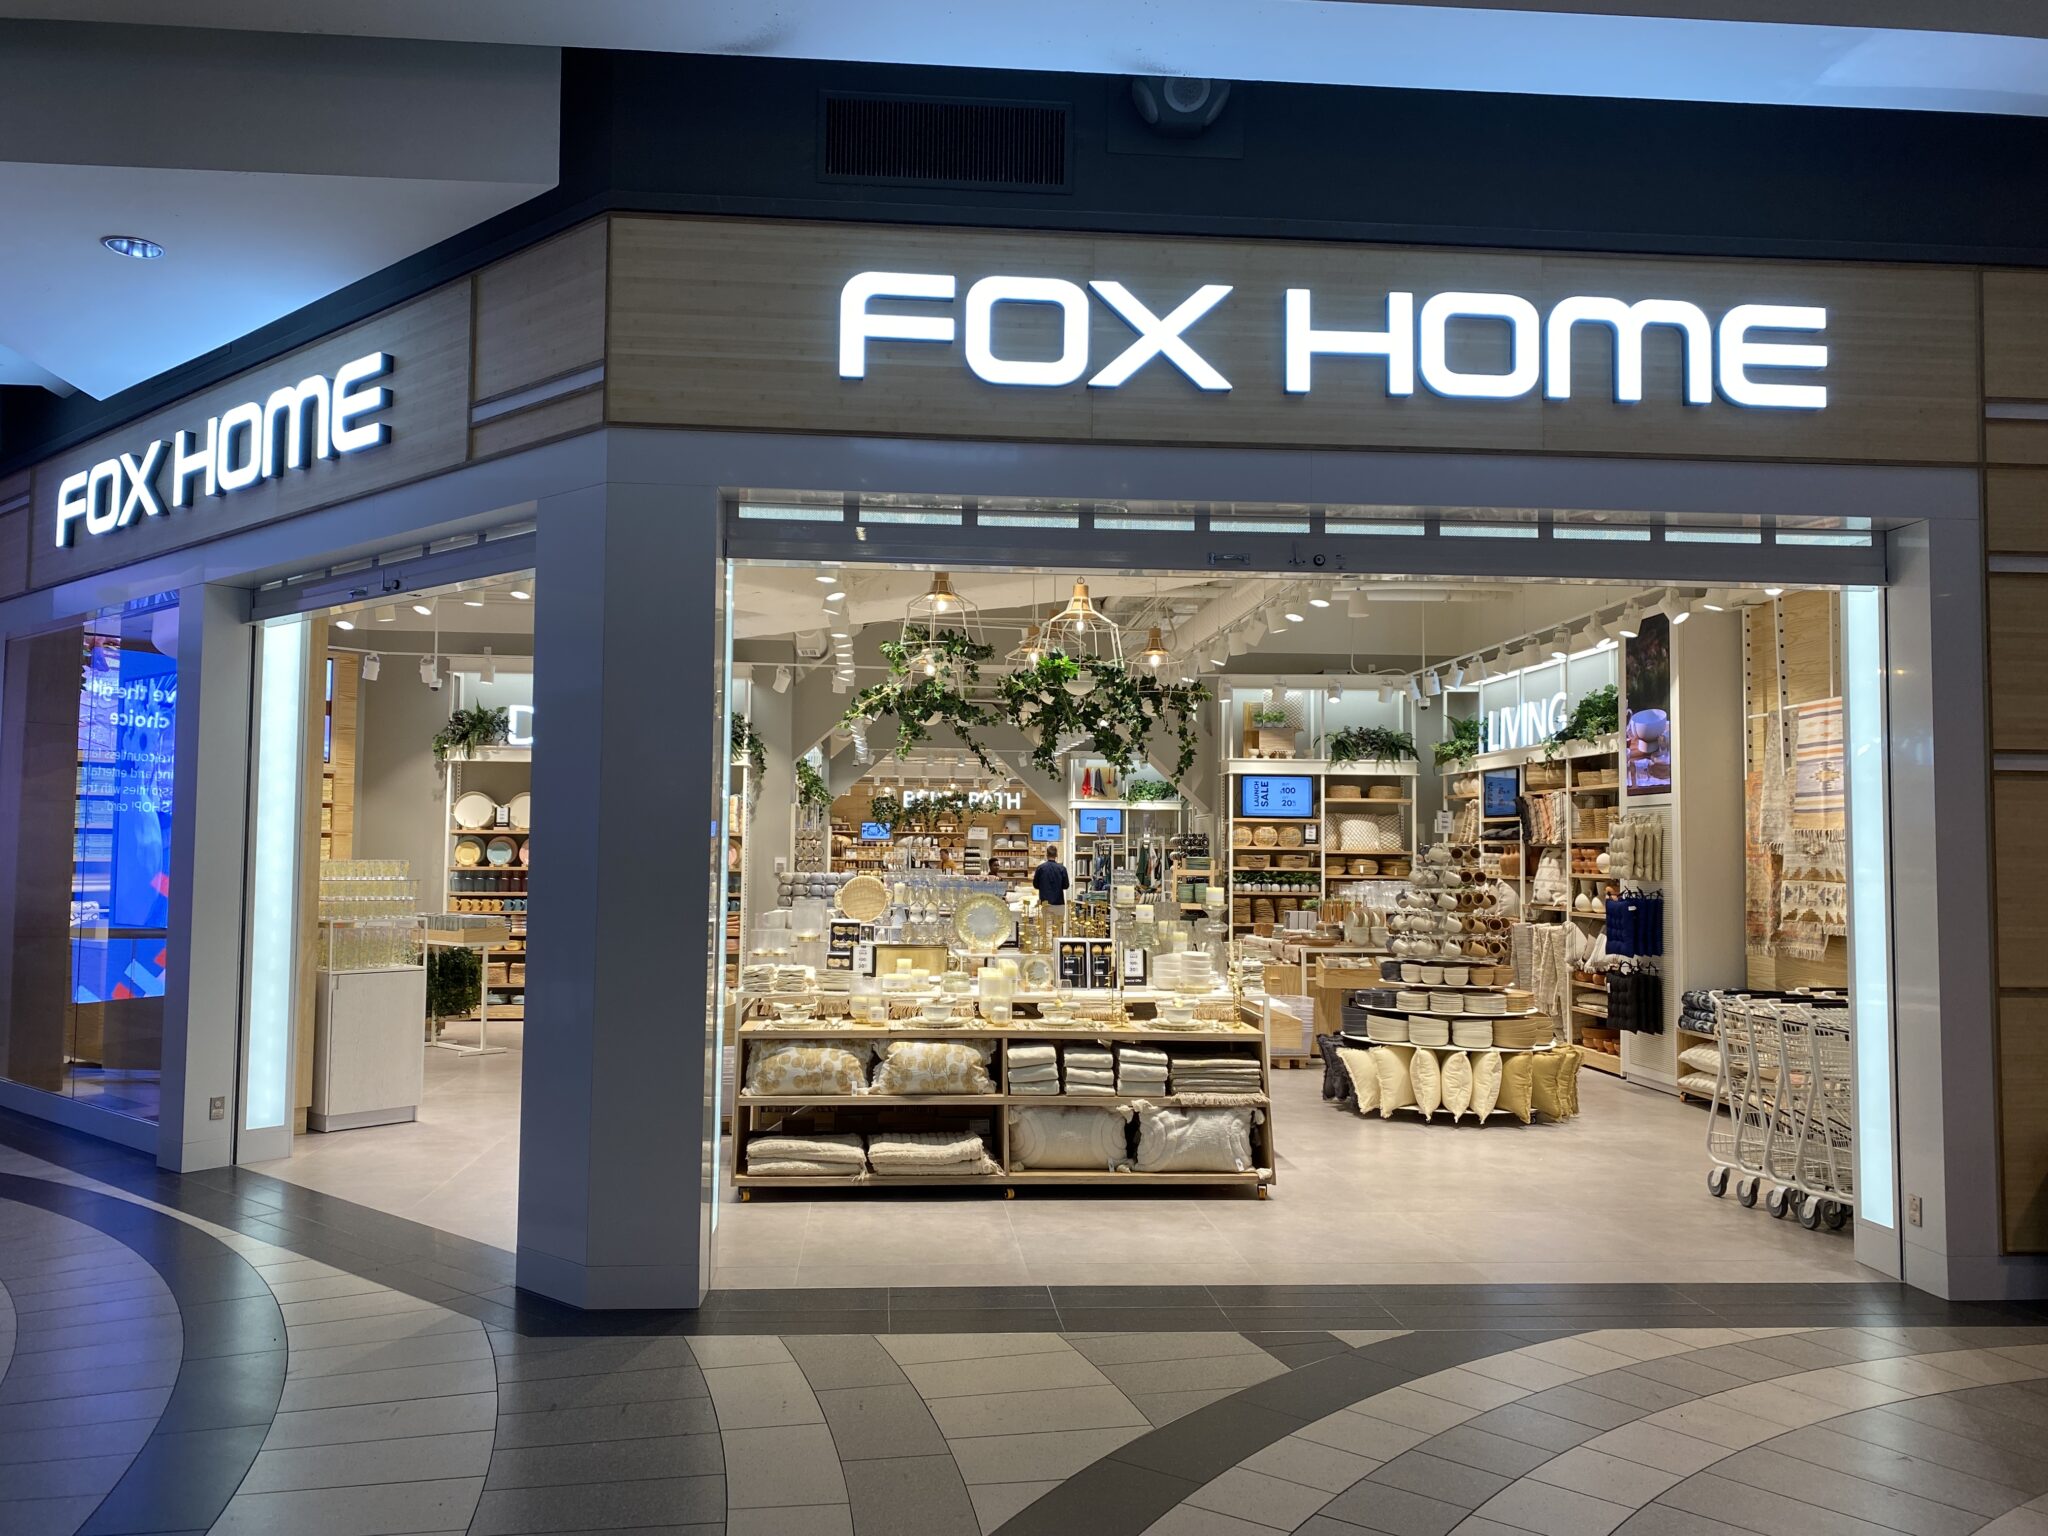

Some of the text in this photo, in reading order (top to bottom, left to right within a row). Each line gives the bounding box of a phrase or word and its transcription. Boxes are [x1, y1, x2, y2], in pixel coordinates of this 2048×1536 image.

[838, 271, 1829, 411] FOX HOME
[55, 351, 393, 549] FOX HOME
[1487, 691, 1568, 752] LIVING
[1260, 781, 1269, 808] SALE
